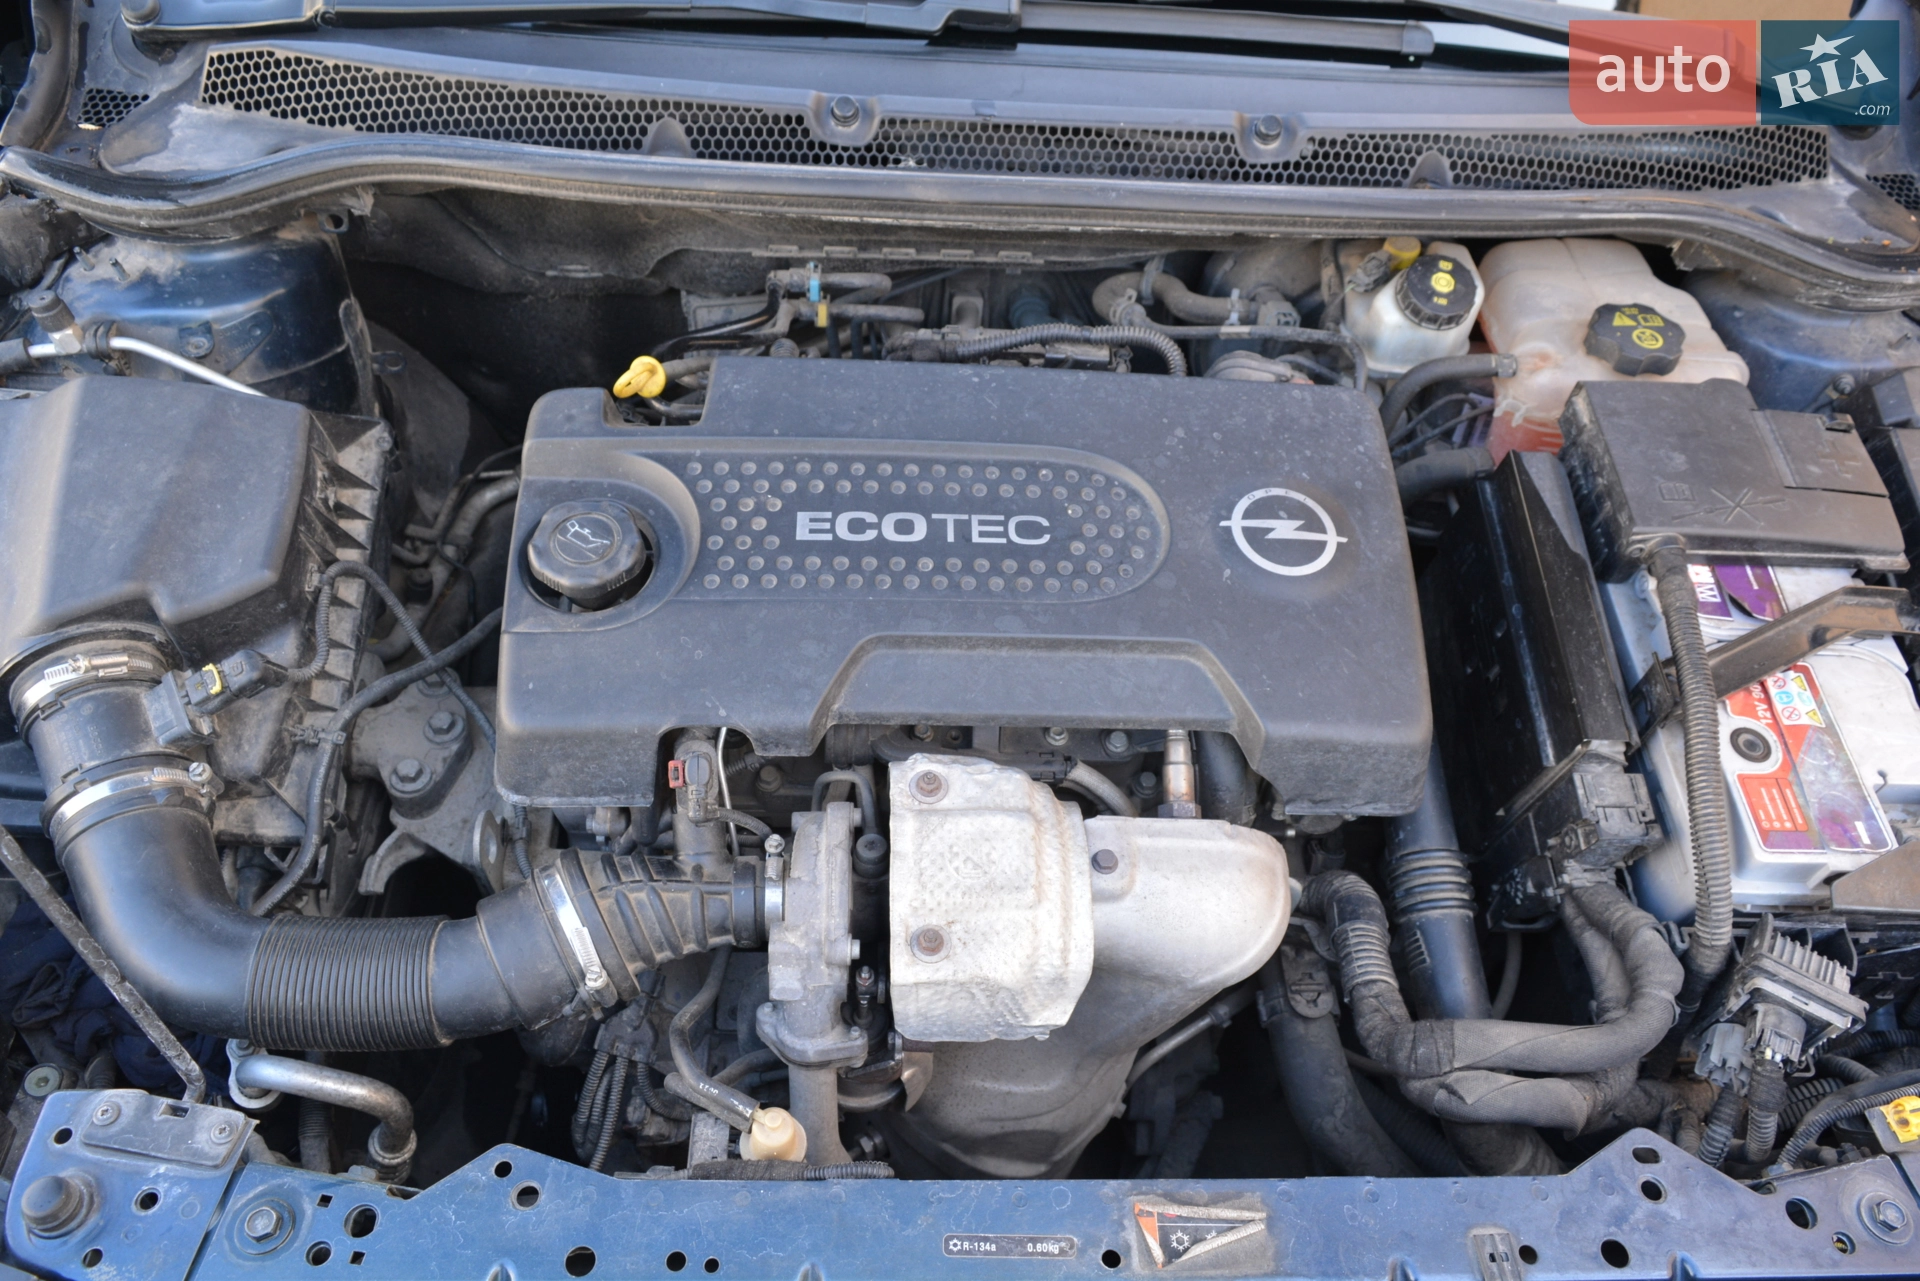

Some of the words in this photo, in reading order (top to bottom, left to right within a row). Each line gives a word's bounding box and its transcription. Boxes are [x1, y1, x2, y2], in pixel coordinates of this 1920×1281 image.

[1247, 488, 1308, 502] OPEL
[795, 511, 1051, 545] ECOTEC
[1749, 680, 1765, 698] 90
[1754, 702, 1773, 726] 12V
[963, 1241, 997, 1252] R-134a
[1027, 1243, 1060, 1254] 0.60kg
